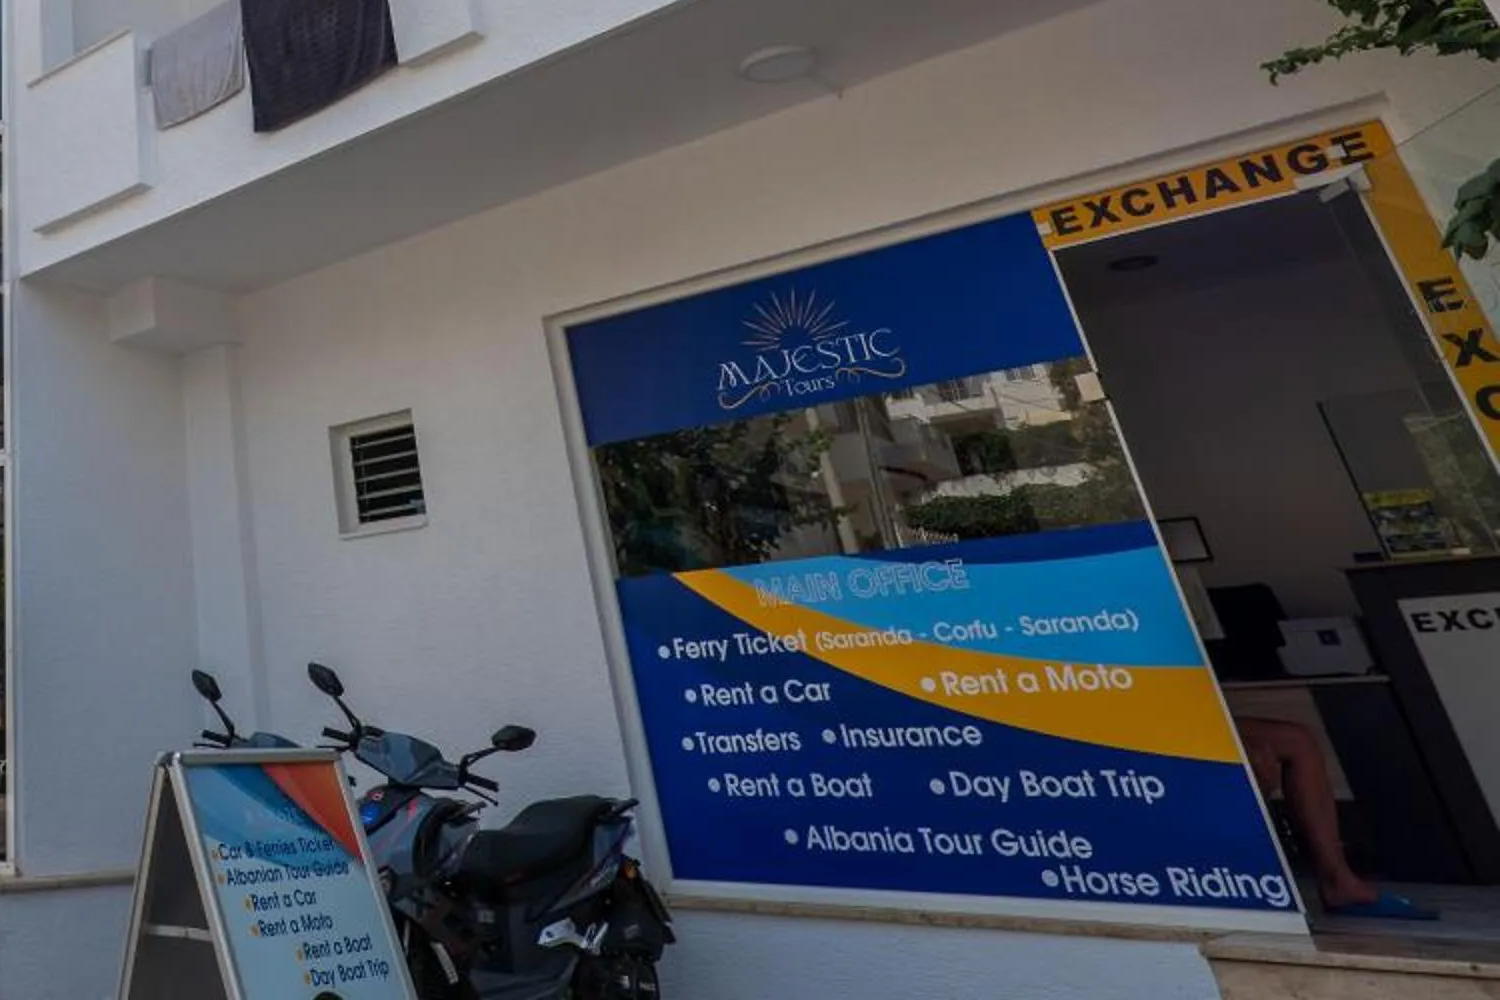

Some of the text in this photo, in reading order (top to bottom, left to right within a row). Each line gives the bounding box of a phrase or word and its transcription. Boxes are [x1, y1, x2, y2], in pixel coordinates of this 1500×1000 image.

[1050, 131, 1375, 236] EXCHANGE
[716, 328, 900, 390] MAJESTIC
[782, 373, 836, 396] Tours
[753, 558, 970, 608] MAIN OFFICE
[672, 637, 728, 661] Ferry
[733, 630, 806, 656] Ticket
[815, 626, 913, 652] (Saranda
[933, 619, 998, 643] Corfu
[1019, 608, 1139, 638] Saranda)
[700, 679, 831, 706] Rent a Car
[939, 663, 1133, 697] Rent a Moto
[695, 728, 801, 755] Transfers
[839, 723, 983, 748] Insurance
[723, 772, 874, 798] Rent a Boat
[948, 769, 1165, 804] Day Boat Trip
[218, 843, 243, 861] Car
[805, 823, 1093, 859] Albania Tour Guide
[227, 859, 350, 886] Albanian Tour Guide
[1059, 865, 1291, 907] Horse Riding
[250, 888, 317, 912] Rent a Car
[258, 912, 334, 937] Rent a Moto
[302, 933, 373, 960] Rent a Boat
[310, 958, 390, 989] Day Boat Trip
